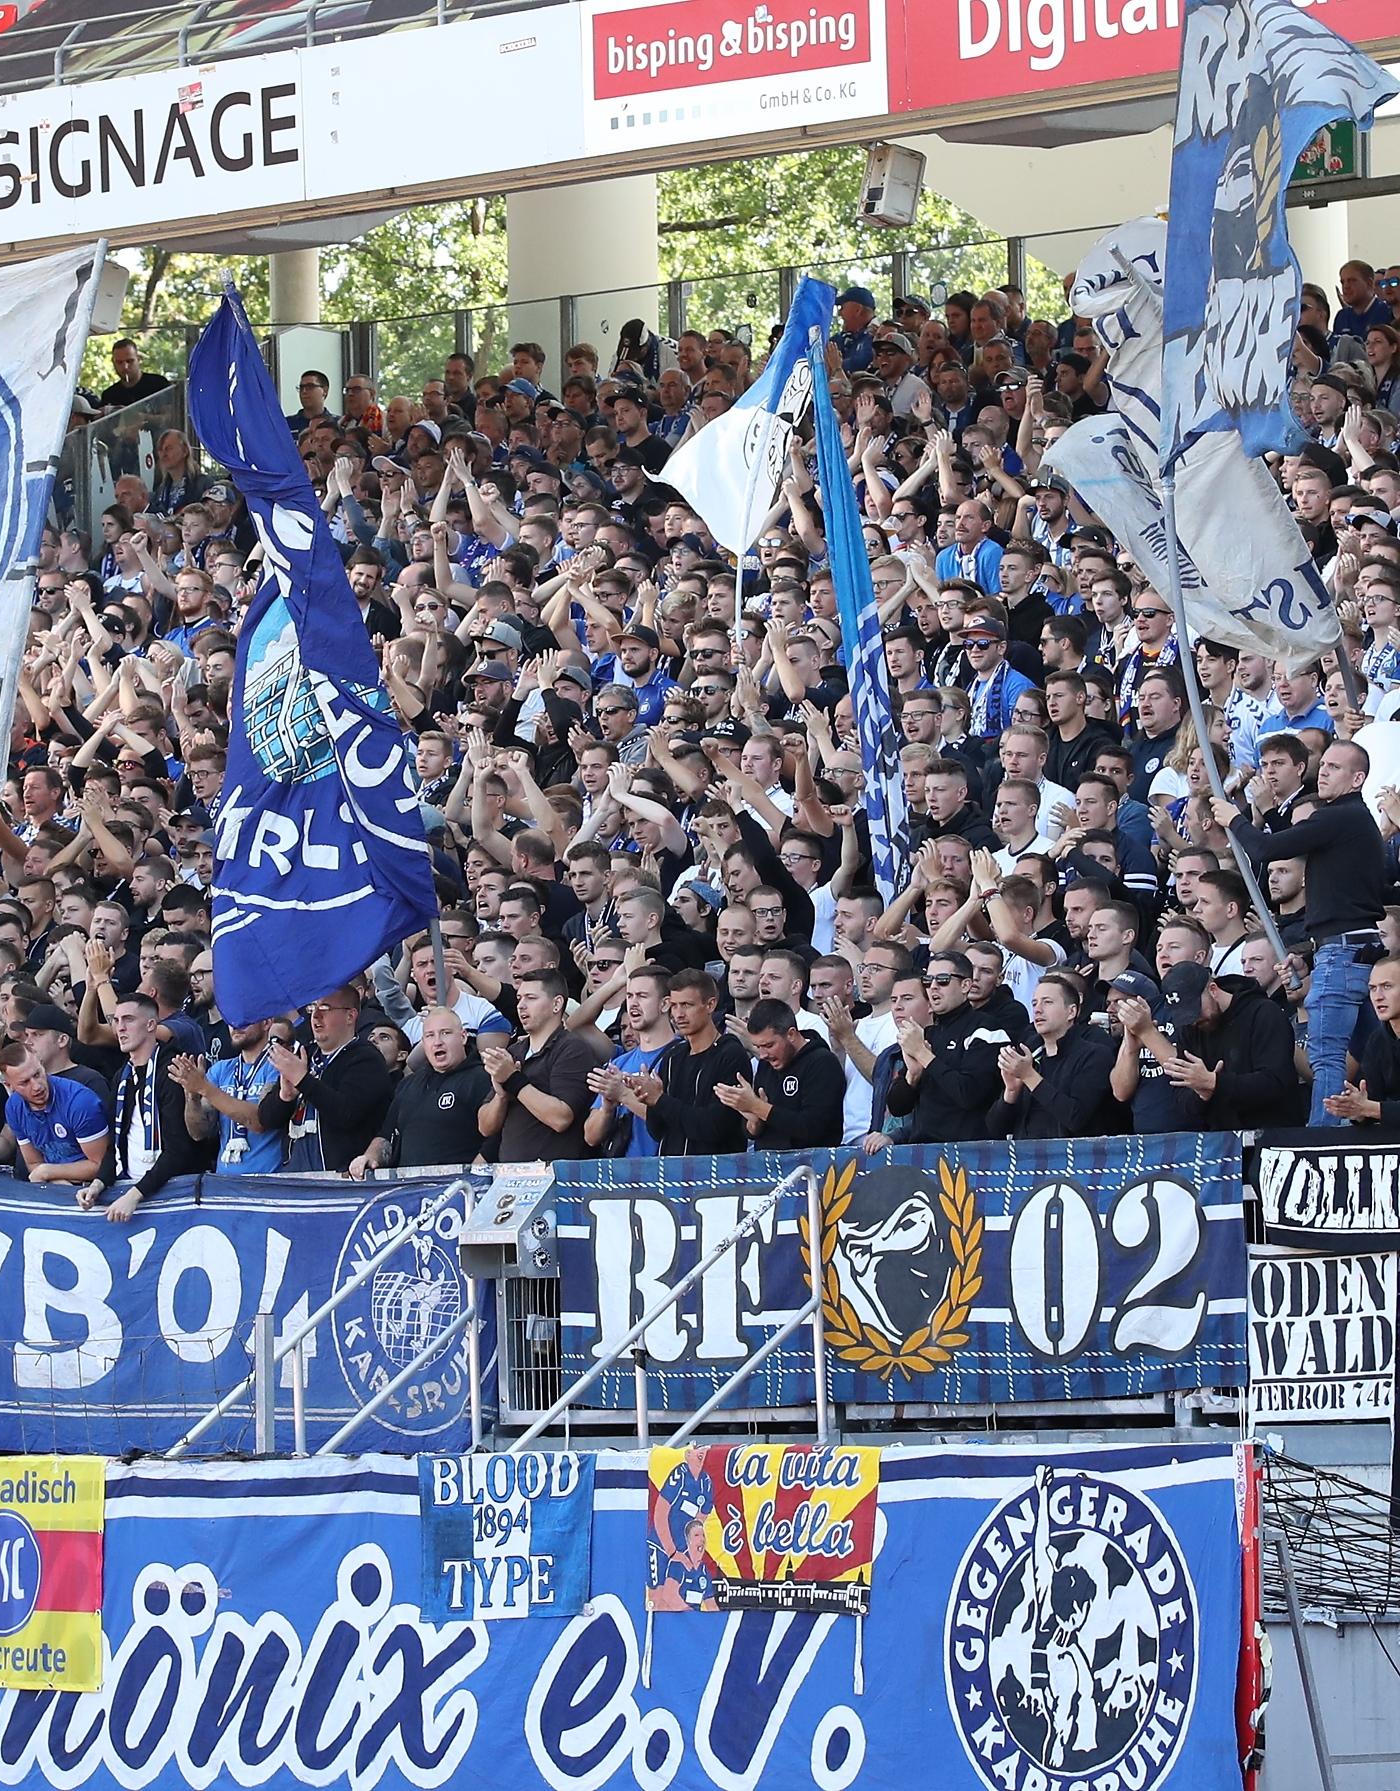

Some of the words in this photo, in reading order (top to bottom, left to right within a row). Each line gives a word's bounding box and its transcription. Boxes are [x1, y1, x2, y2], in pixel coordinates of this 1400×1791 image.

[607, 28, 714, 78] bisping
[747, 7, 856, 58] bisping
[759, 87, 800, 110] GmbH
[802, 87, 813, 104] &
[815, 86, 836, 102] Co.
[839, 81, 857, 98] KG
[1258, 1147, 1400, 1230] VOLLK
[588, 1196, 784, 1364] RF
[1010, 1179, 1206, 1358] 02
[1250, 1254, 1390, 1318] ODEN
[1251, 1315, 1394, 1377] WALD
[1252, 1383, 1346, 1412] TERROR
[1352, 1380, 1393, 1409] 747
[431, 1448, 579, 1507] BLOOD
[472, 1503, 529, 1547] 1894
[751, 1500, 855, 1559] bella
[441, 1554, 556, 1610] TYPE
